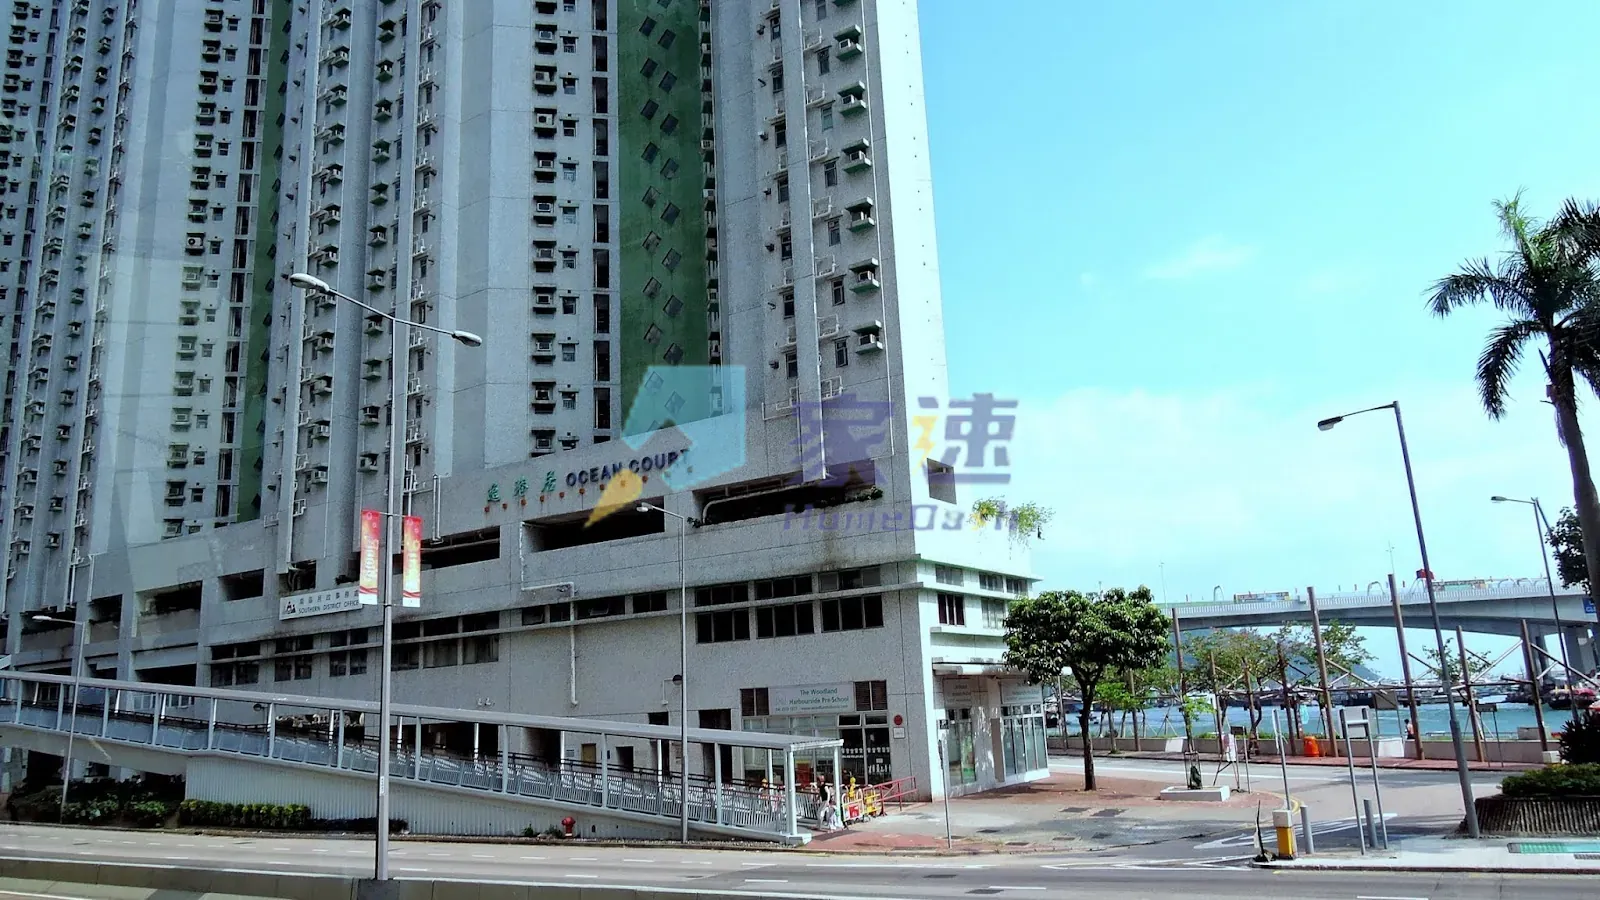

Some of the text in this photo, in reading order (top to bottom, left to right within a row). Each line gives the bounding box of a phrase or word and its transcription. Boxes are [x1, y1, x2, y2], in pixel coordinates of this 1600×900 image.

[566, 462, 624, 486] OCEAN
[323, 602, 342, 611] DISTRICT
[344, 600, 359, 608] OFFICE
[811, 687, 838, 695] Woodland
